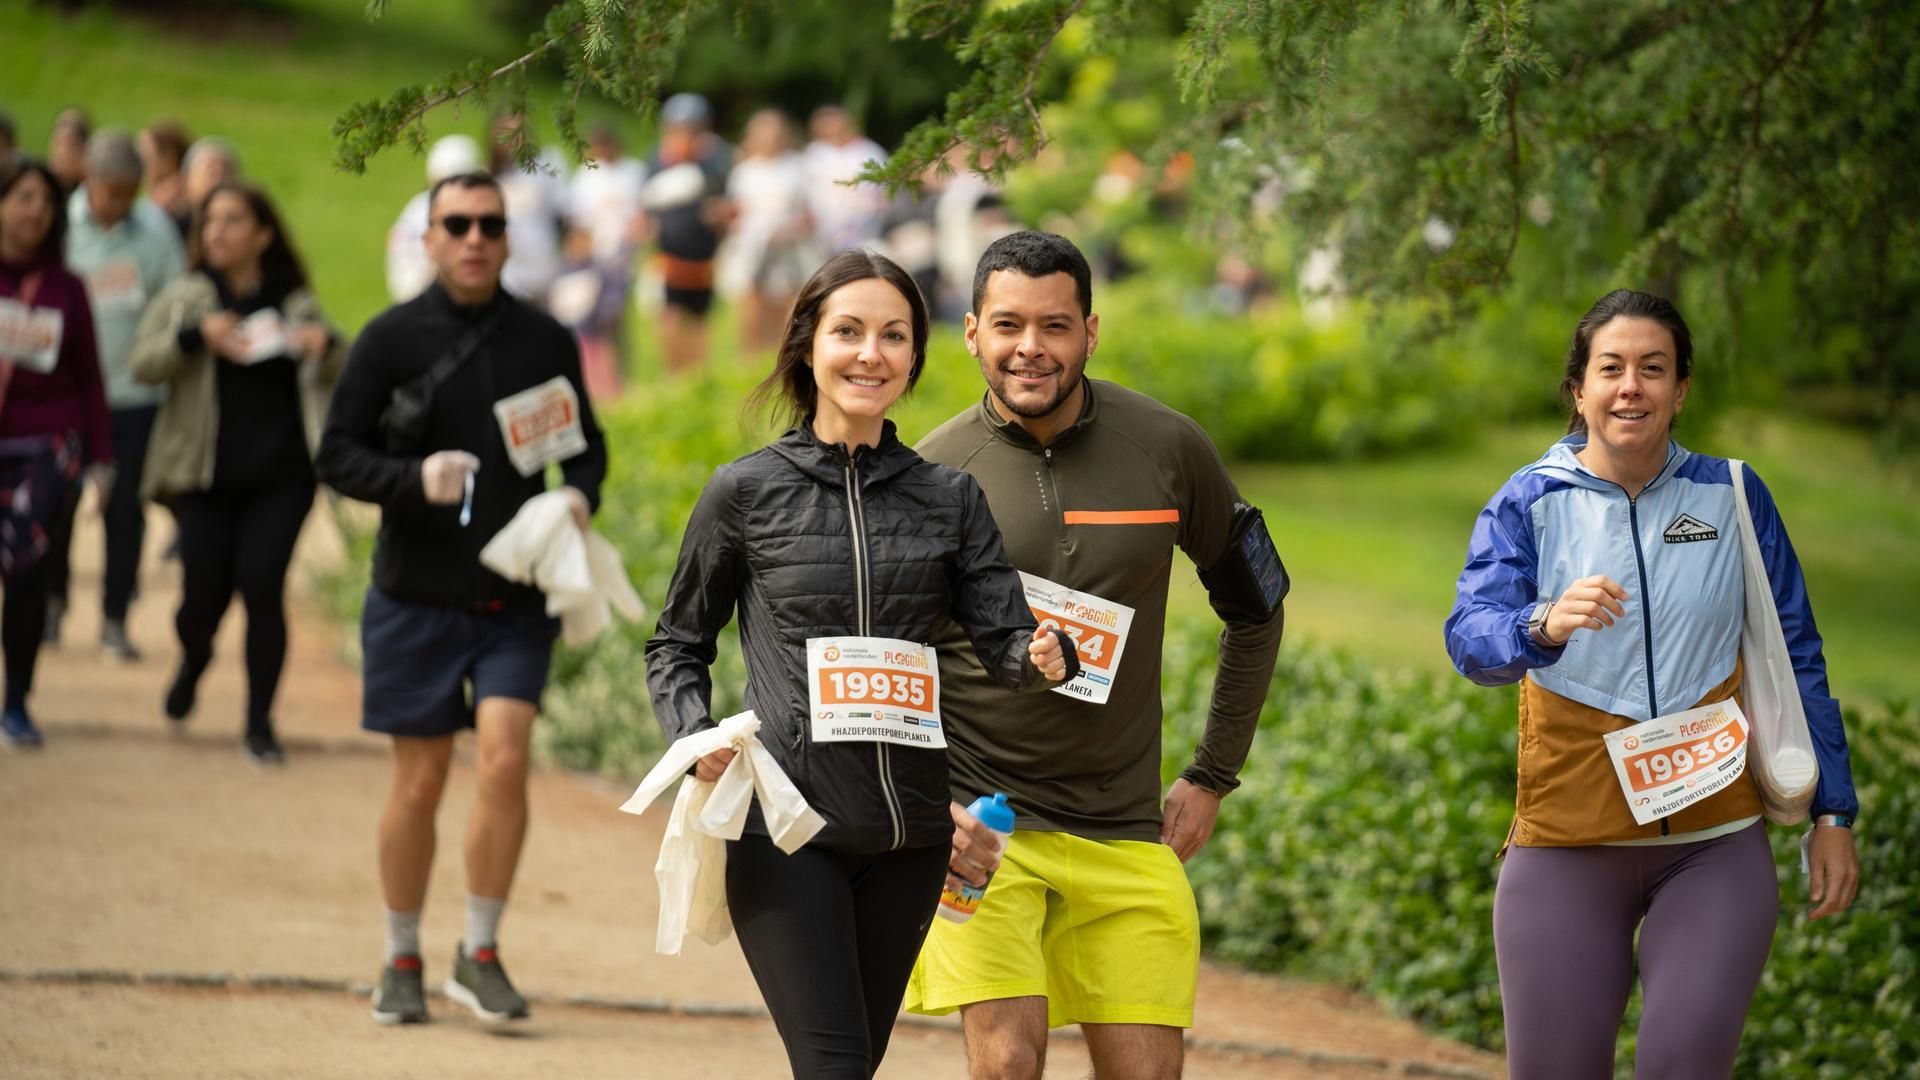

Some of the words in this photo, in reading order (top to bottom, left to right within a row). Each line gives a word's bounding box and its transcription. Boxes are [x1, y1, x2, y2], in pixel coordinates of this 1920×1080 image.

[1665, 535, 1687, 543] NIKE
[1689, 533, 1717, 541] TRAIL
[1025, 591, 1058, 608] nederlanden
[829, 671, 926, 706] 19935
[831, 726, 931, 743] #HAZDEPORTEPORELPLANETA
[1634, 731, 1736, 785] 19936
